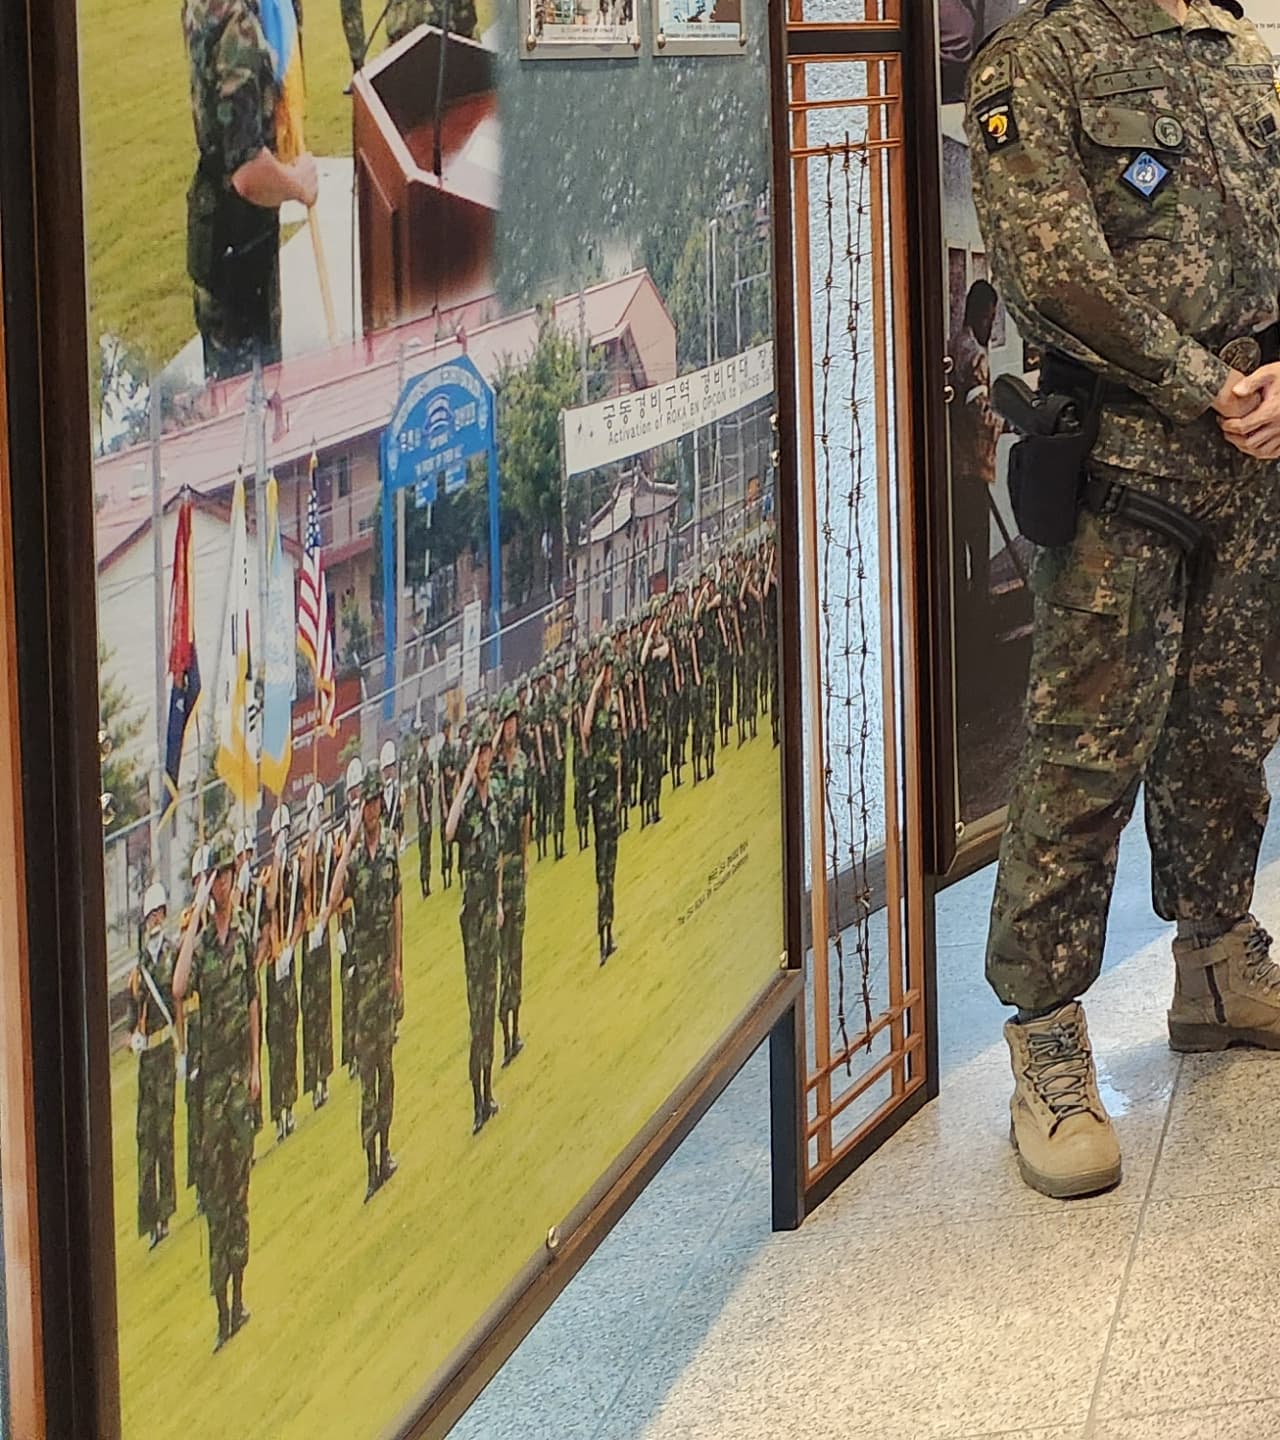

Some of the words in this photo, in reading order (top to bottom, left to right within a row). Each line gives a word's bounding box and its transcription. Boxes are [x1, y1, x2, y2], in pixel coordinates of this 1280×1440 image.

[603, 379, 690, 430] 공동경비구역
[701, 357, 748, 395] 경비대대
[608, 423, 651, 445] Activation
[655, 420, 663, 431] of
[667, 405, 687, 425] ROKA
